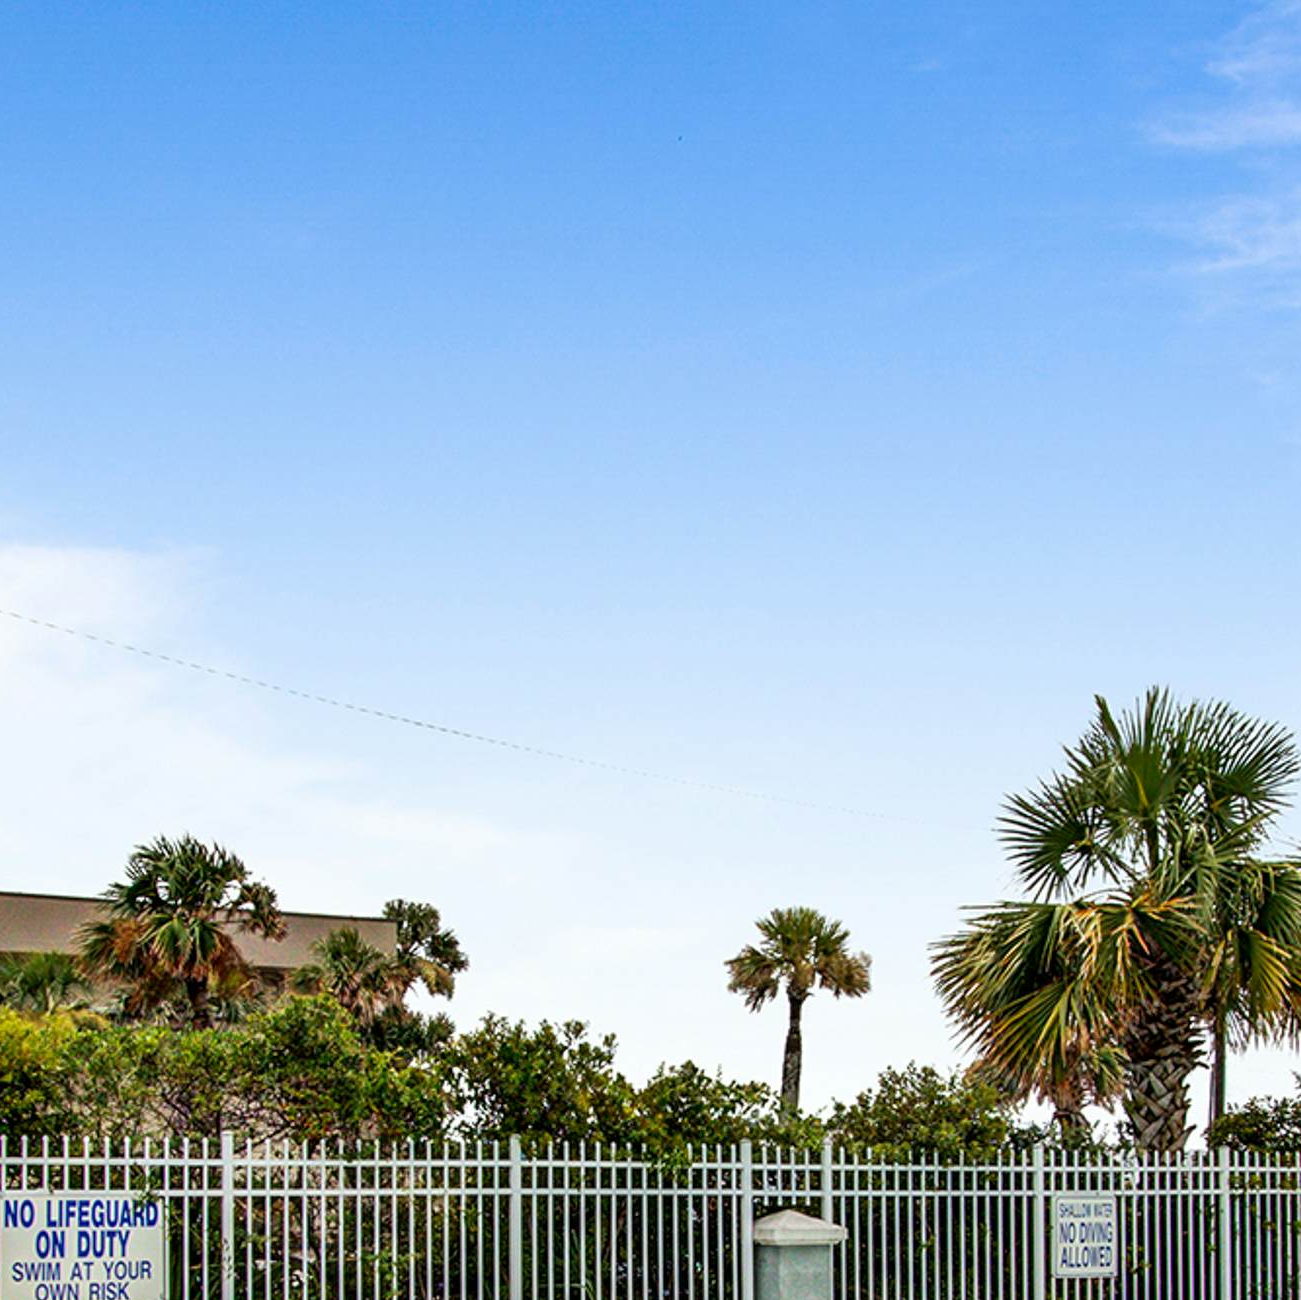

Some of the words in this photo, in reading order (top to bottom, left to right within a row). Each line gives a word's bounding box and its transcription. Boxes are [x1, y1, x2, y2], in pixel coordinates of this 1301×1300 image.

[4, 1200, 35, 1228] NO
[46, 1199, 158, 1228] LIFEGUARD
[1060, 1222, 1076, 1243] NO
[1079, 1222, 1112, 1243] DIVING
[36, 1230, 65, 1259] ON
[77, 1230, 130, 1258] DUTY
[1061, 1246, 1112, 1268] ALLOWED
[12, 1262, 61, 1281] SWIM
[70, 1262, 95, 1280] AT
[103, 1261, 152, 1280] YOUR
[89, 1282, 130, 1300] RISK
